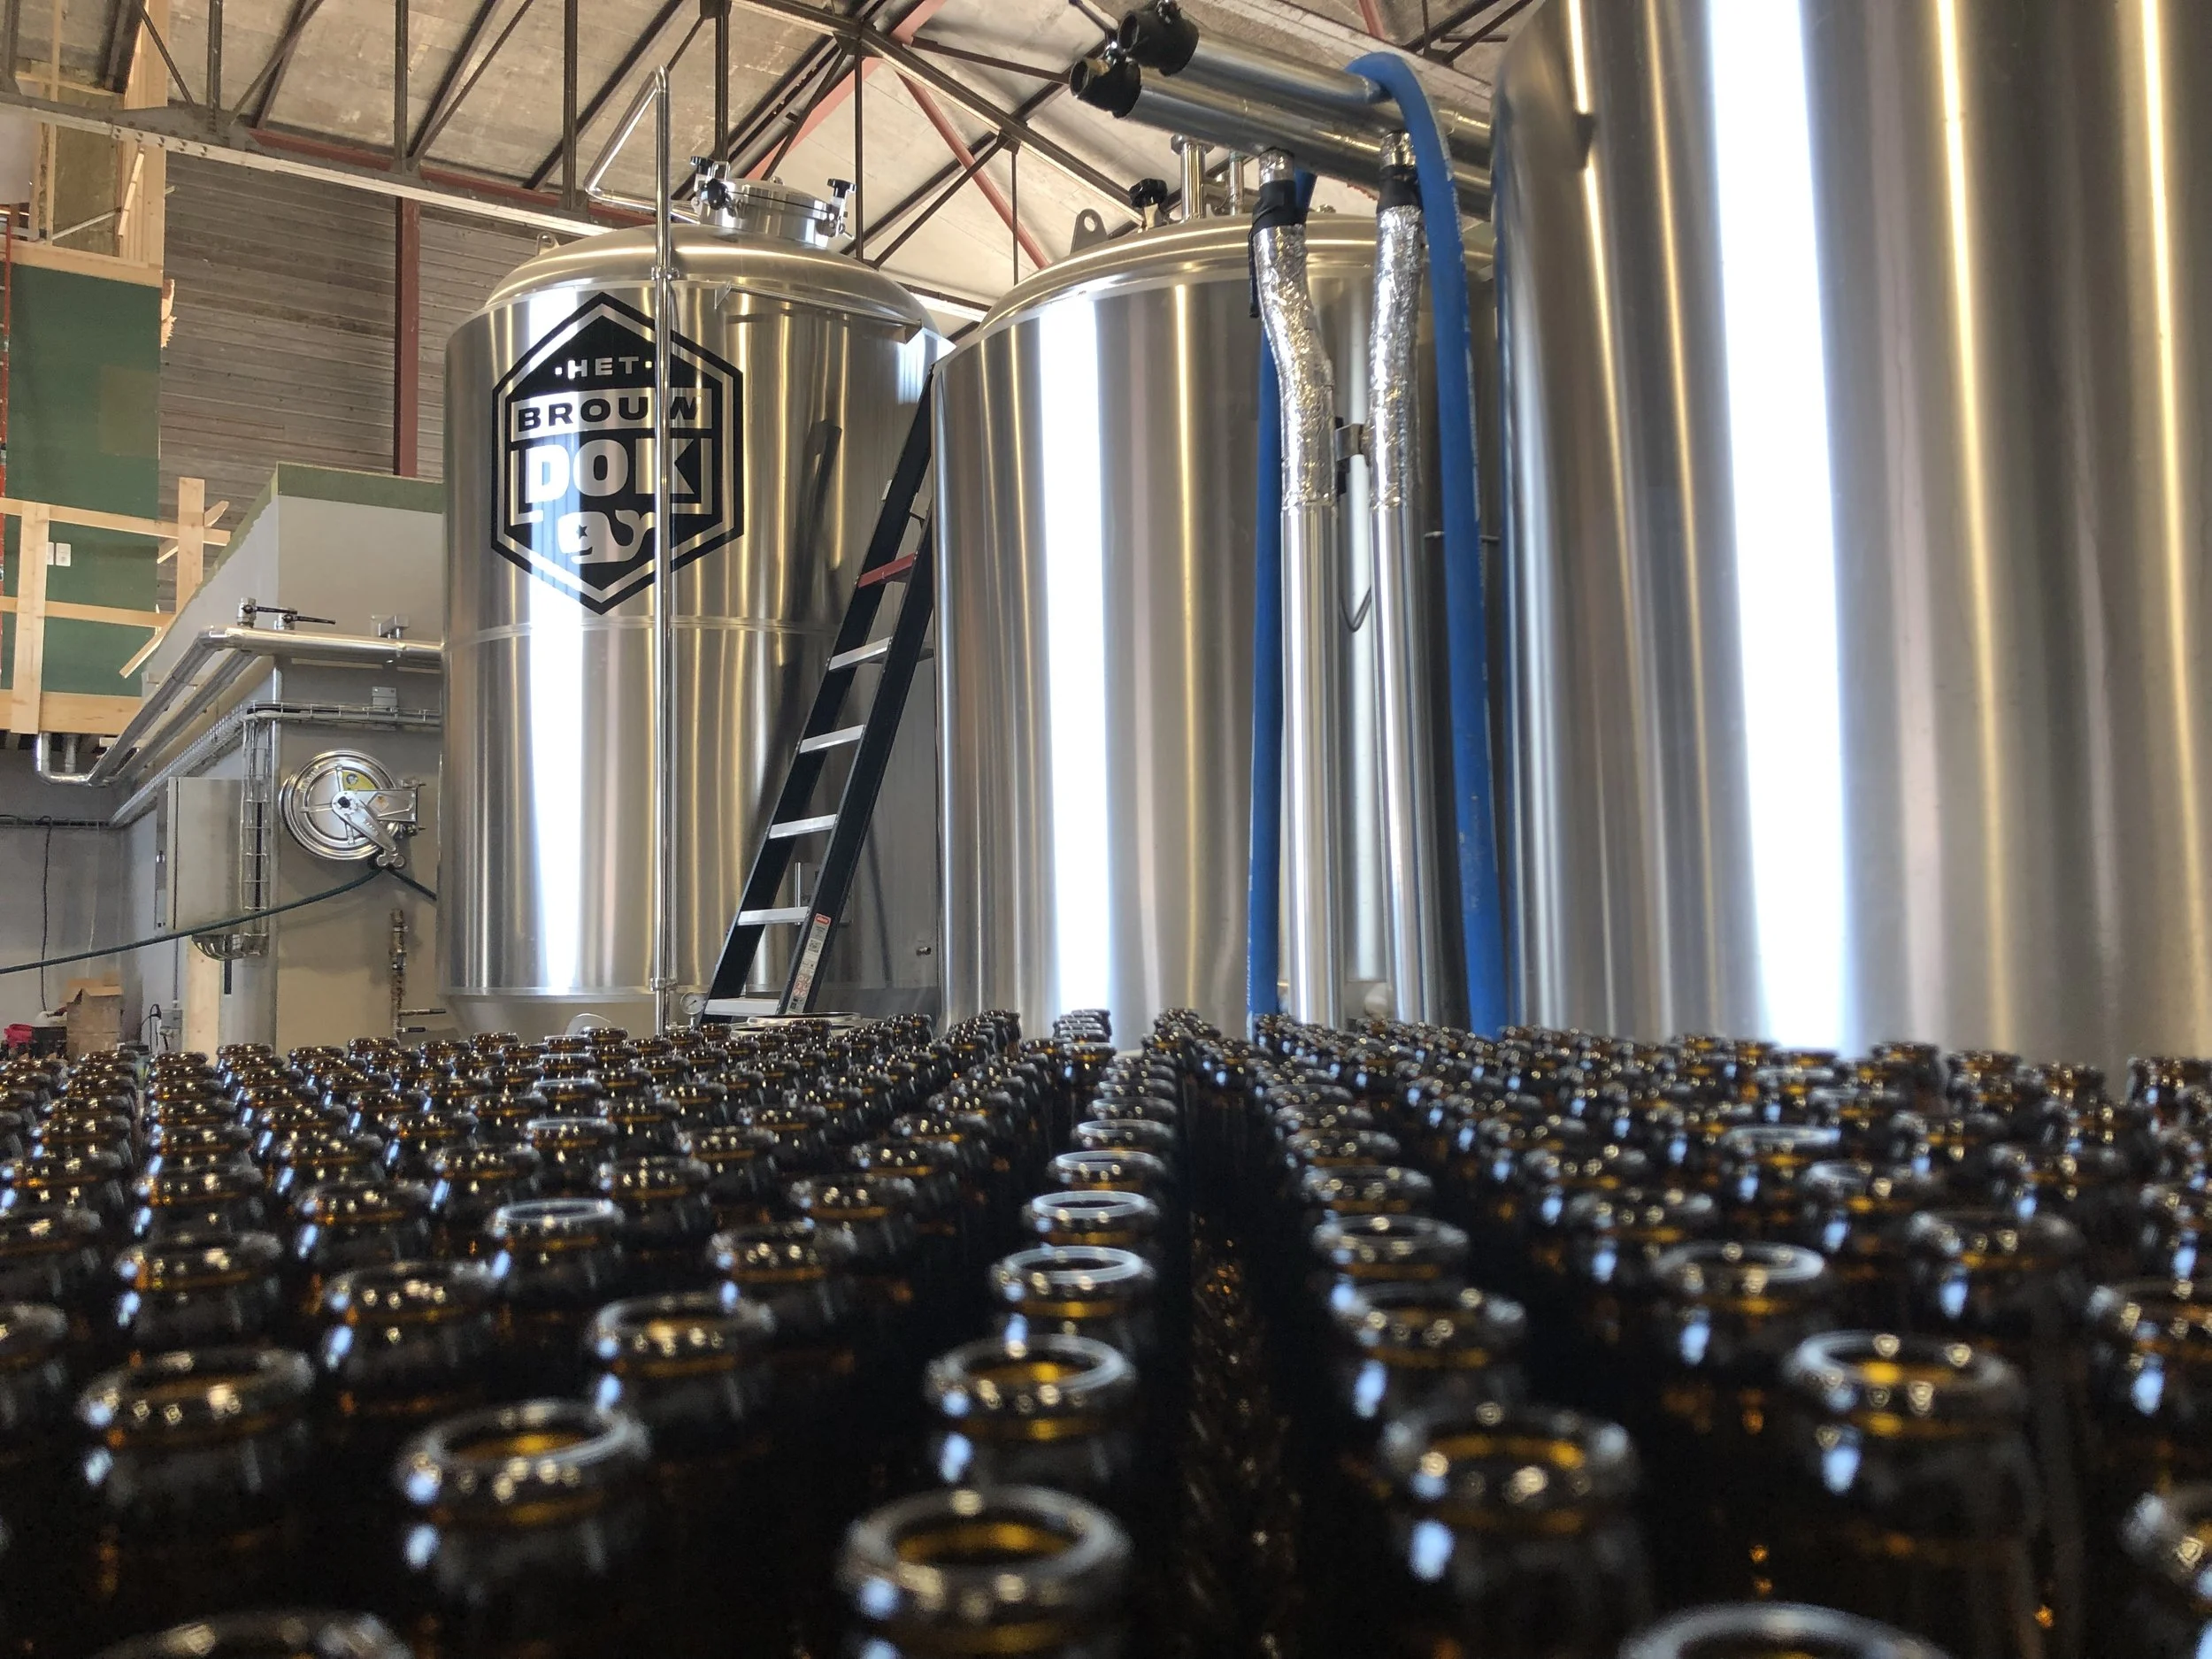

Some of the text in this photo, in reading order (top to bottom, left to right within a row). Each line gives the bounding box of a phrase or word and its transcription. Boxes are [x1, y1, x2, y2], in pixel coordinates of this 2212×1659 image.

[567, 356, 639, 380] HET
[518, 396, 700, 433] BROUW
[525, 439, 695, 503] DOK
